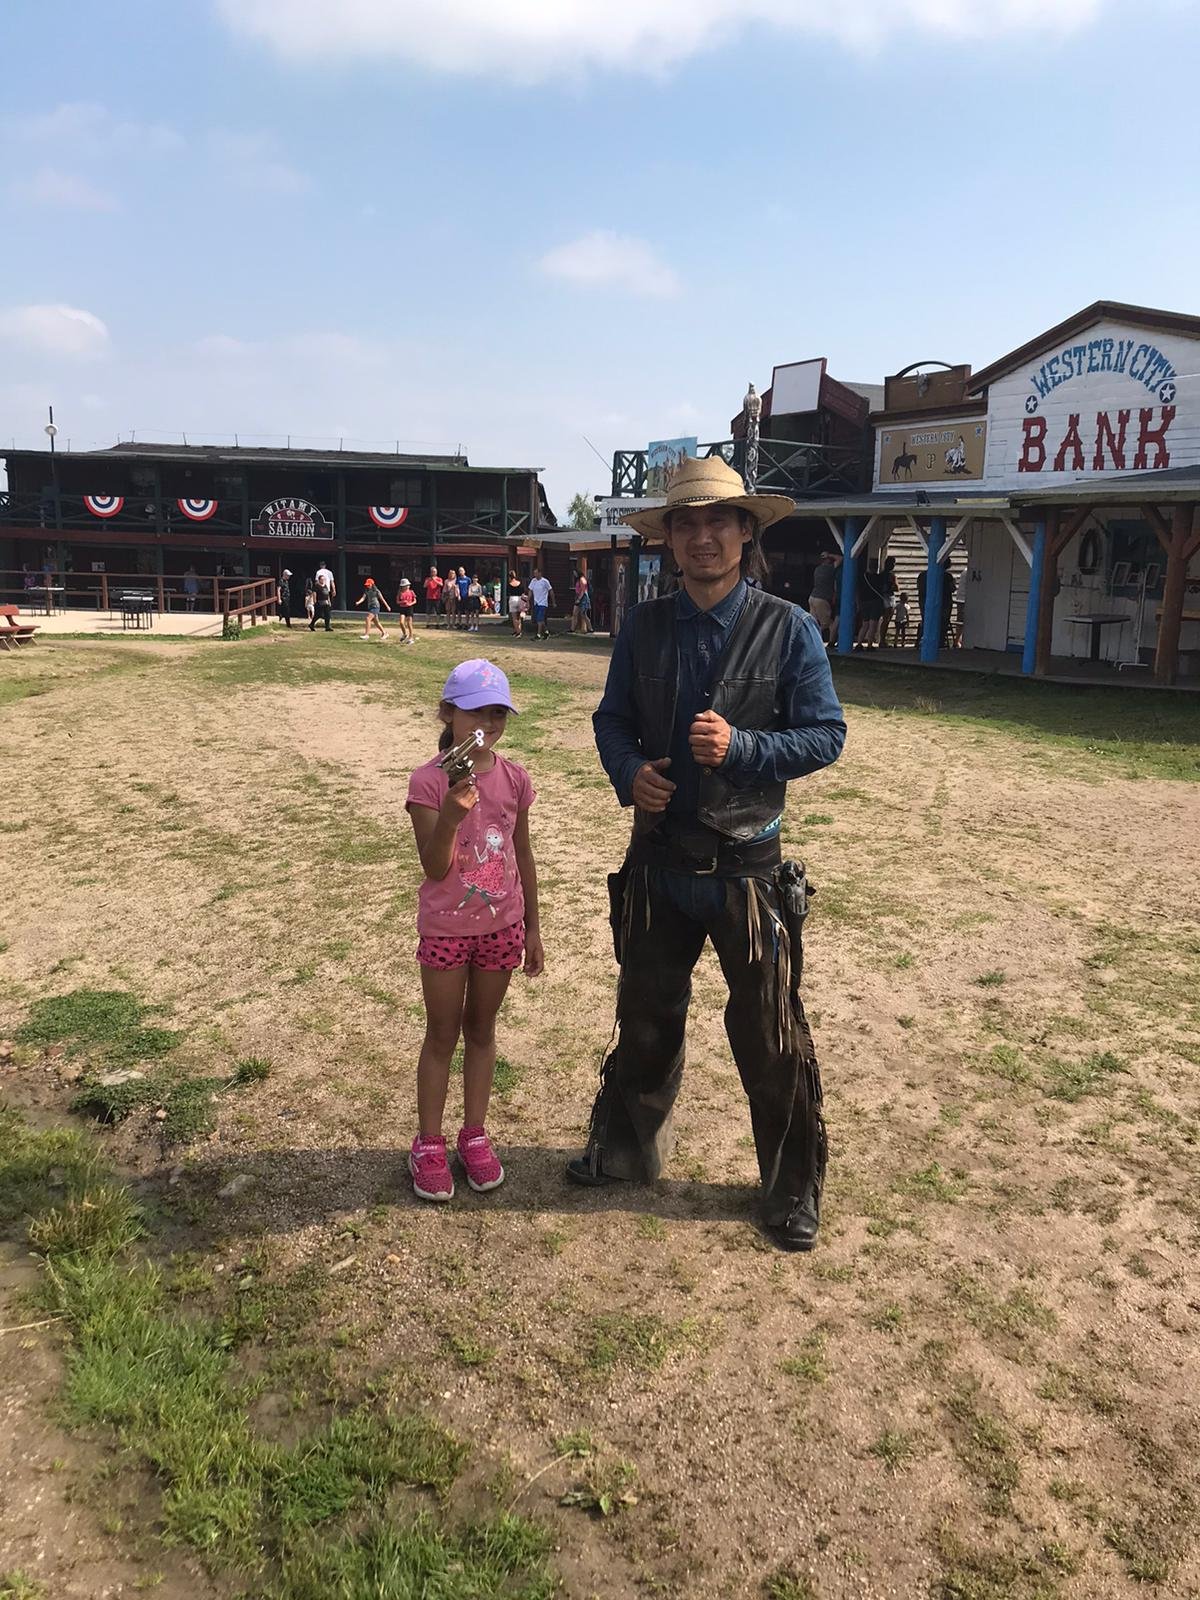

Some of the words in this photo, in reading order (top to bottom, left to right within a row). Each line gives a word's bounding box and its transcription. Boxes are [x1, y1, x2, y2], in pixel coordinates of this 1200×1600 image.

[1031, 337, 1134, 399] WESTERN
[1129, 344, 1177, 393] CITY
[1017, 405, 1177, 473] BANK
[265, 499, 317, 516] WITAMY
[268, 521, 316, 537] SALOON
